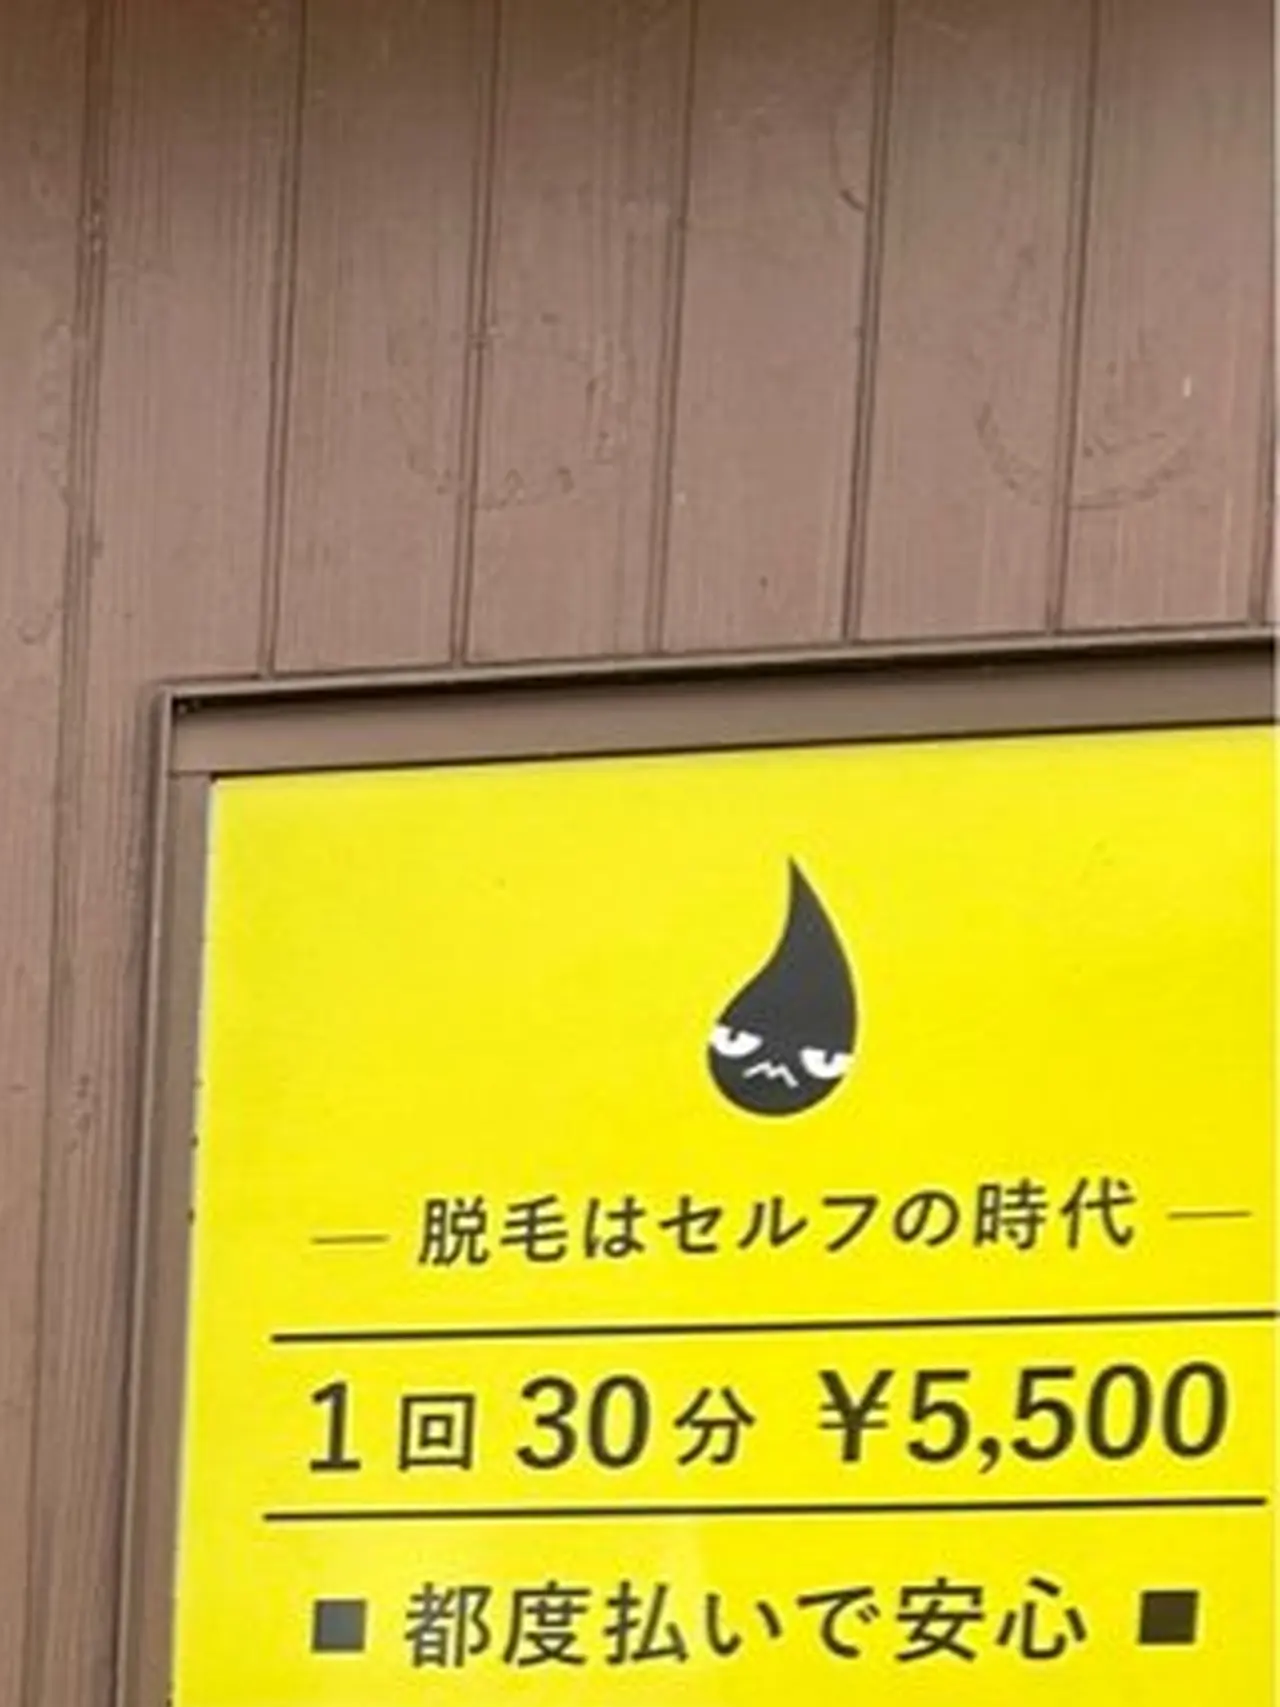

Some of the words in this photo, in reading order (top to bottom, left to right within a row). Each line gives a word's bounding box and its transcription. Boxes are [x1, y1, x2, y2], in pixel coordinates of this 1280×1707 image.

[417, 1176, 1139, 1268] 脱毛はセルフの時代
[819, 1361, 1229, 1476] ¥5,500
[404, 1577, 1089, 1671] 都度払いで安心
